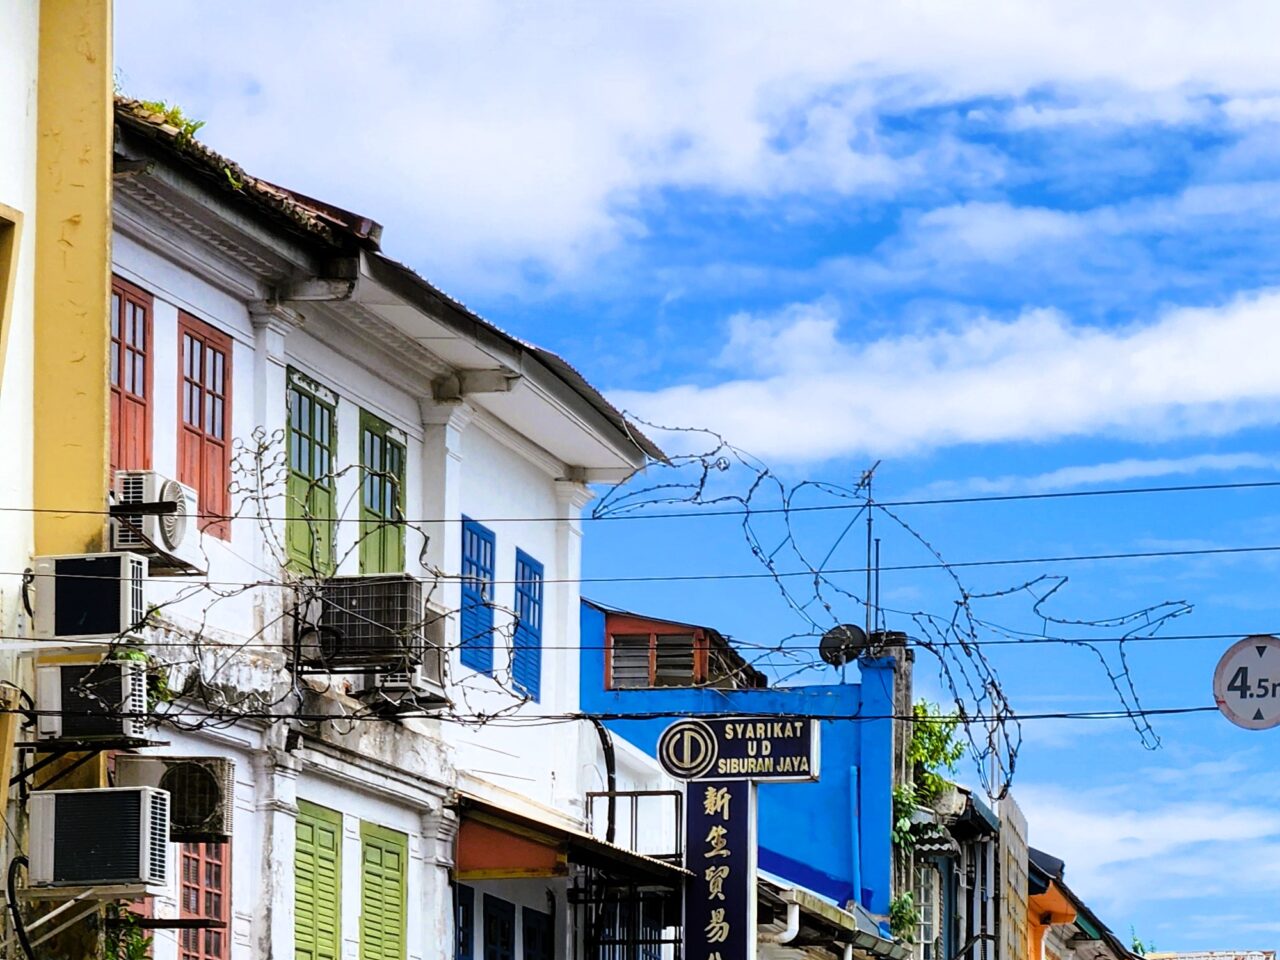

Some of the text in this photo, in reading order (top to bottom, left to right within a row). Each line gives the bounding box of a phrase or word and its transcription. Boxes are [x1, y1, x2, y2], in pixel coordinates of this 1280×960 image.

[725, 722, 803, 739] SYARIKAT
[718, 756, 809, 774] SIBURAN JAYA
